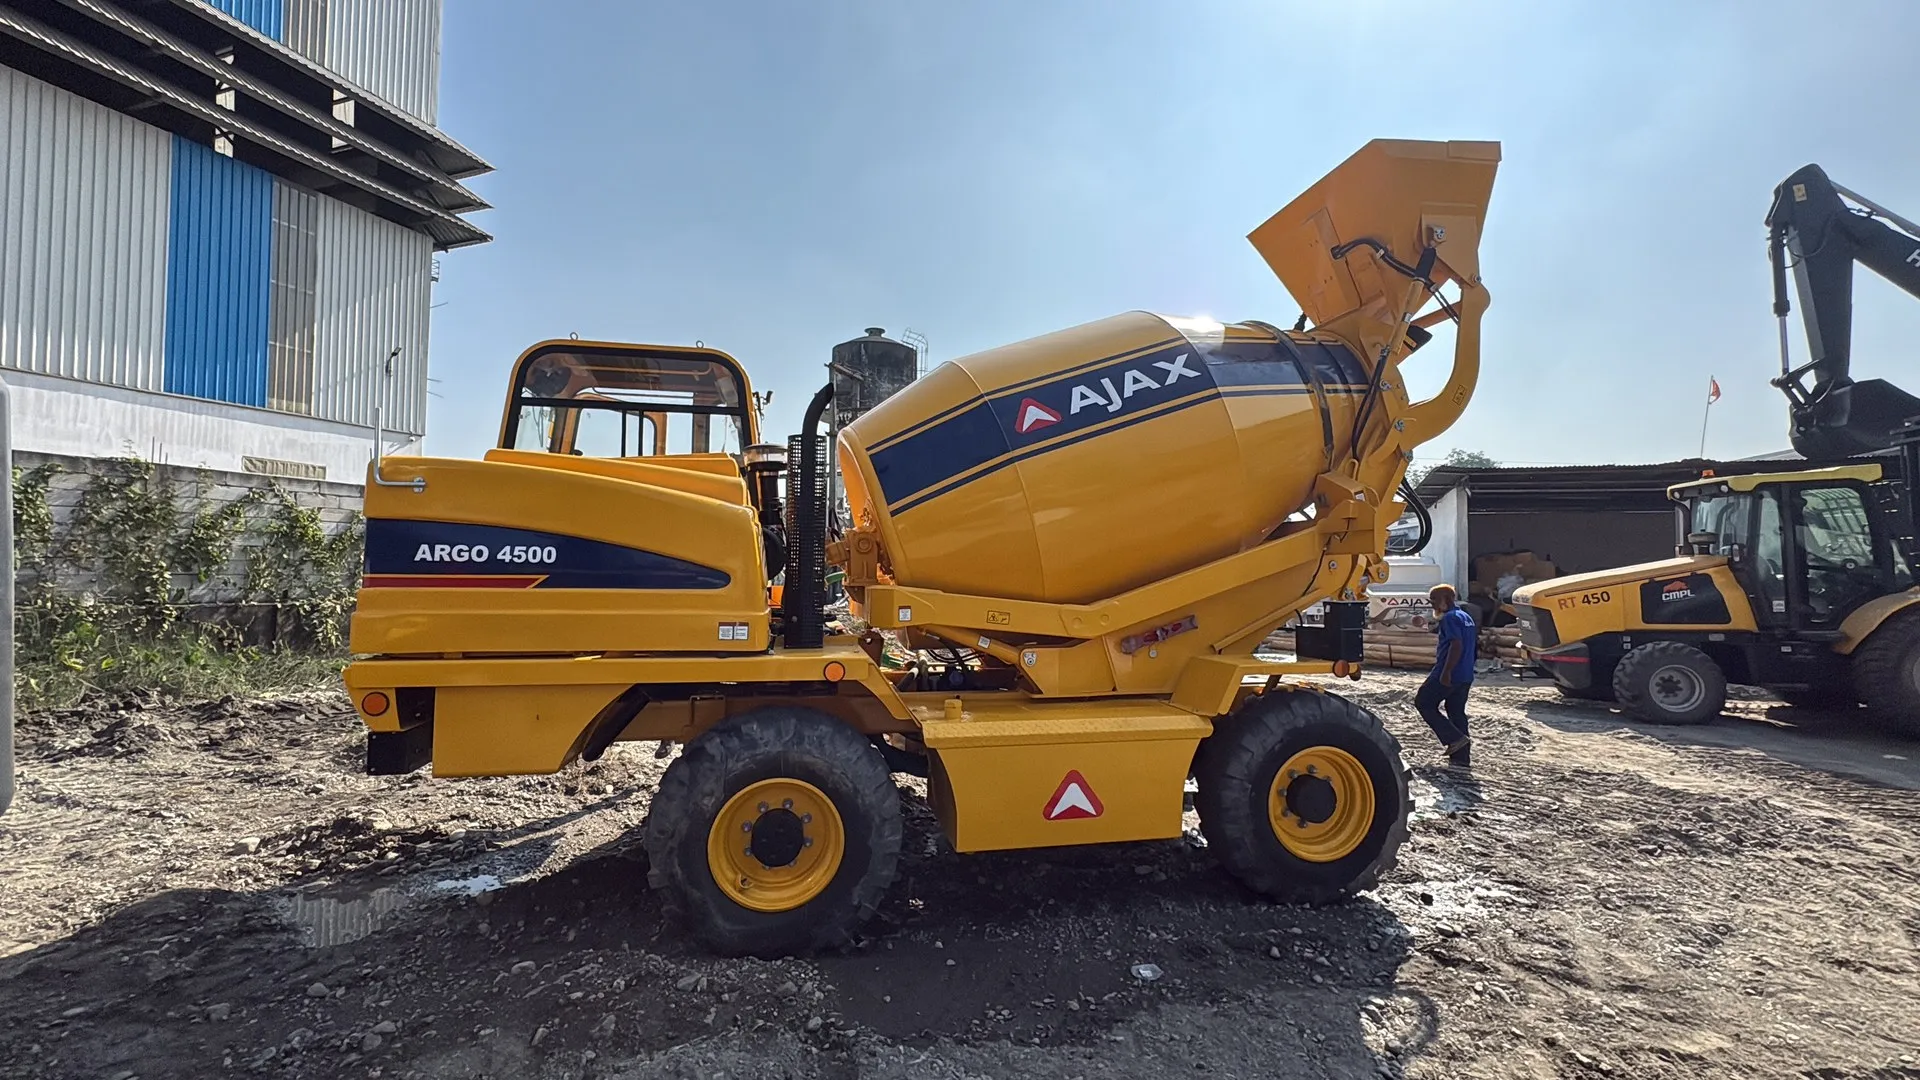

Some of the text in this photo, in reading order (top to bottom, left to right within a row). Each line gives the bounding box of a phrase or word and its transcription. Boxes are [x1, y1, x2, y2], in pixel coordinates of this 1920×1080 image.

[1070, 353, 1201, 415] AJAX
[414, 544, 557, 563] ARGO 4500
[1557, 590, 1610, 610] RT 450
[1662, 590, 1696, 601] CMPL
